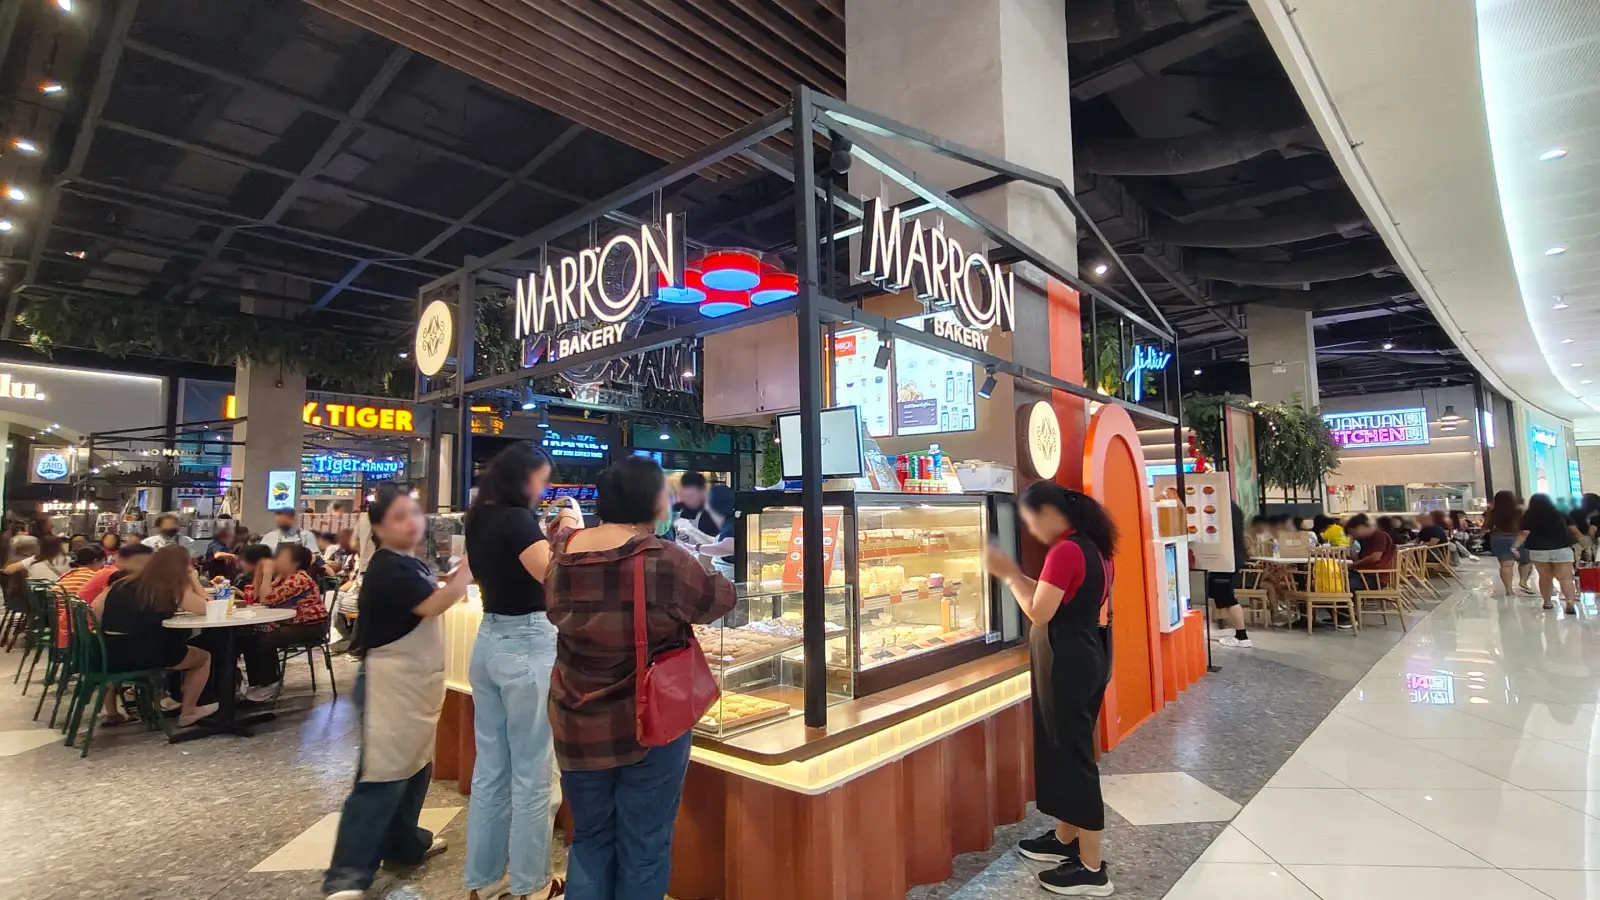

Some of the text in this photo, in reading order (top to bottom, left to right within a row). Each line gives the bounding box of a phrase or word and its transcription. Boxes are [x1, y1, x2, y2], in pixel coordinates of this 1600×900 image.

[515, 212, 674, 340] MARRON
[869, 197, 1016, 332] MARRON
[558, 320, 627, 359] BAKERY
[933, 317, 990, 352] BAKERY
[325, 403, 413, 432] TIGER
[315, 454, 399, 473] Tiger MANJU
